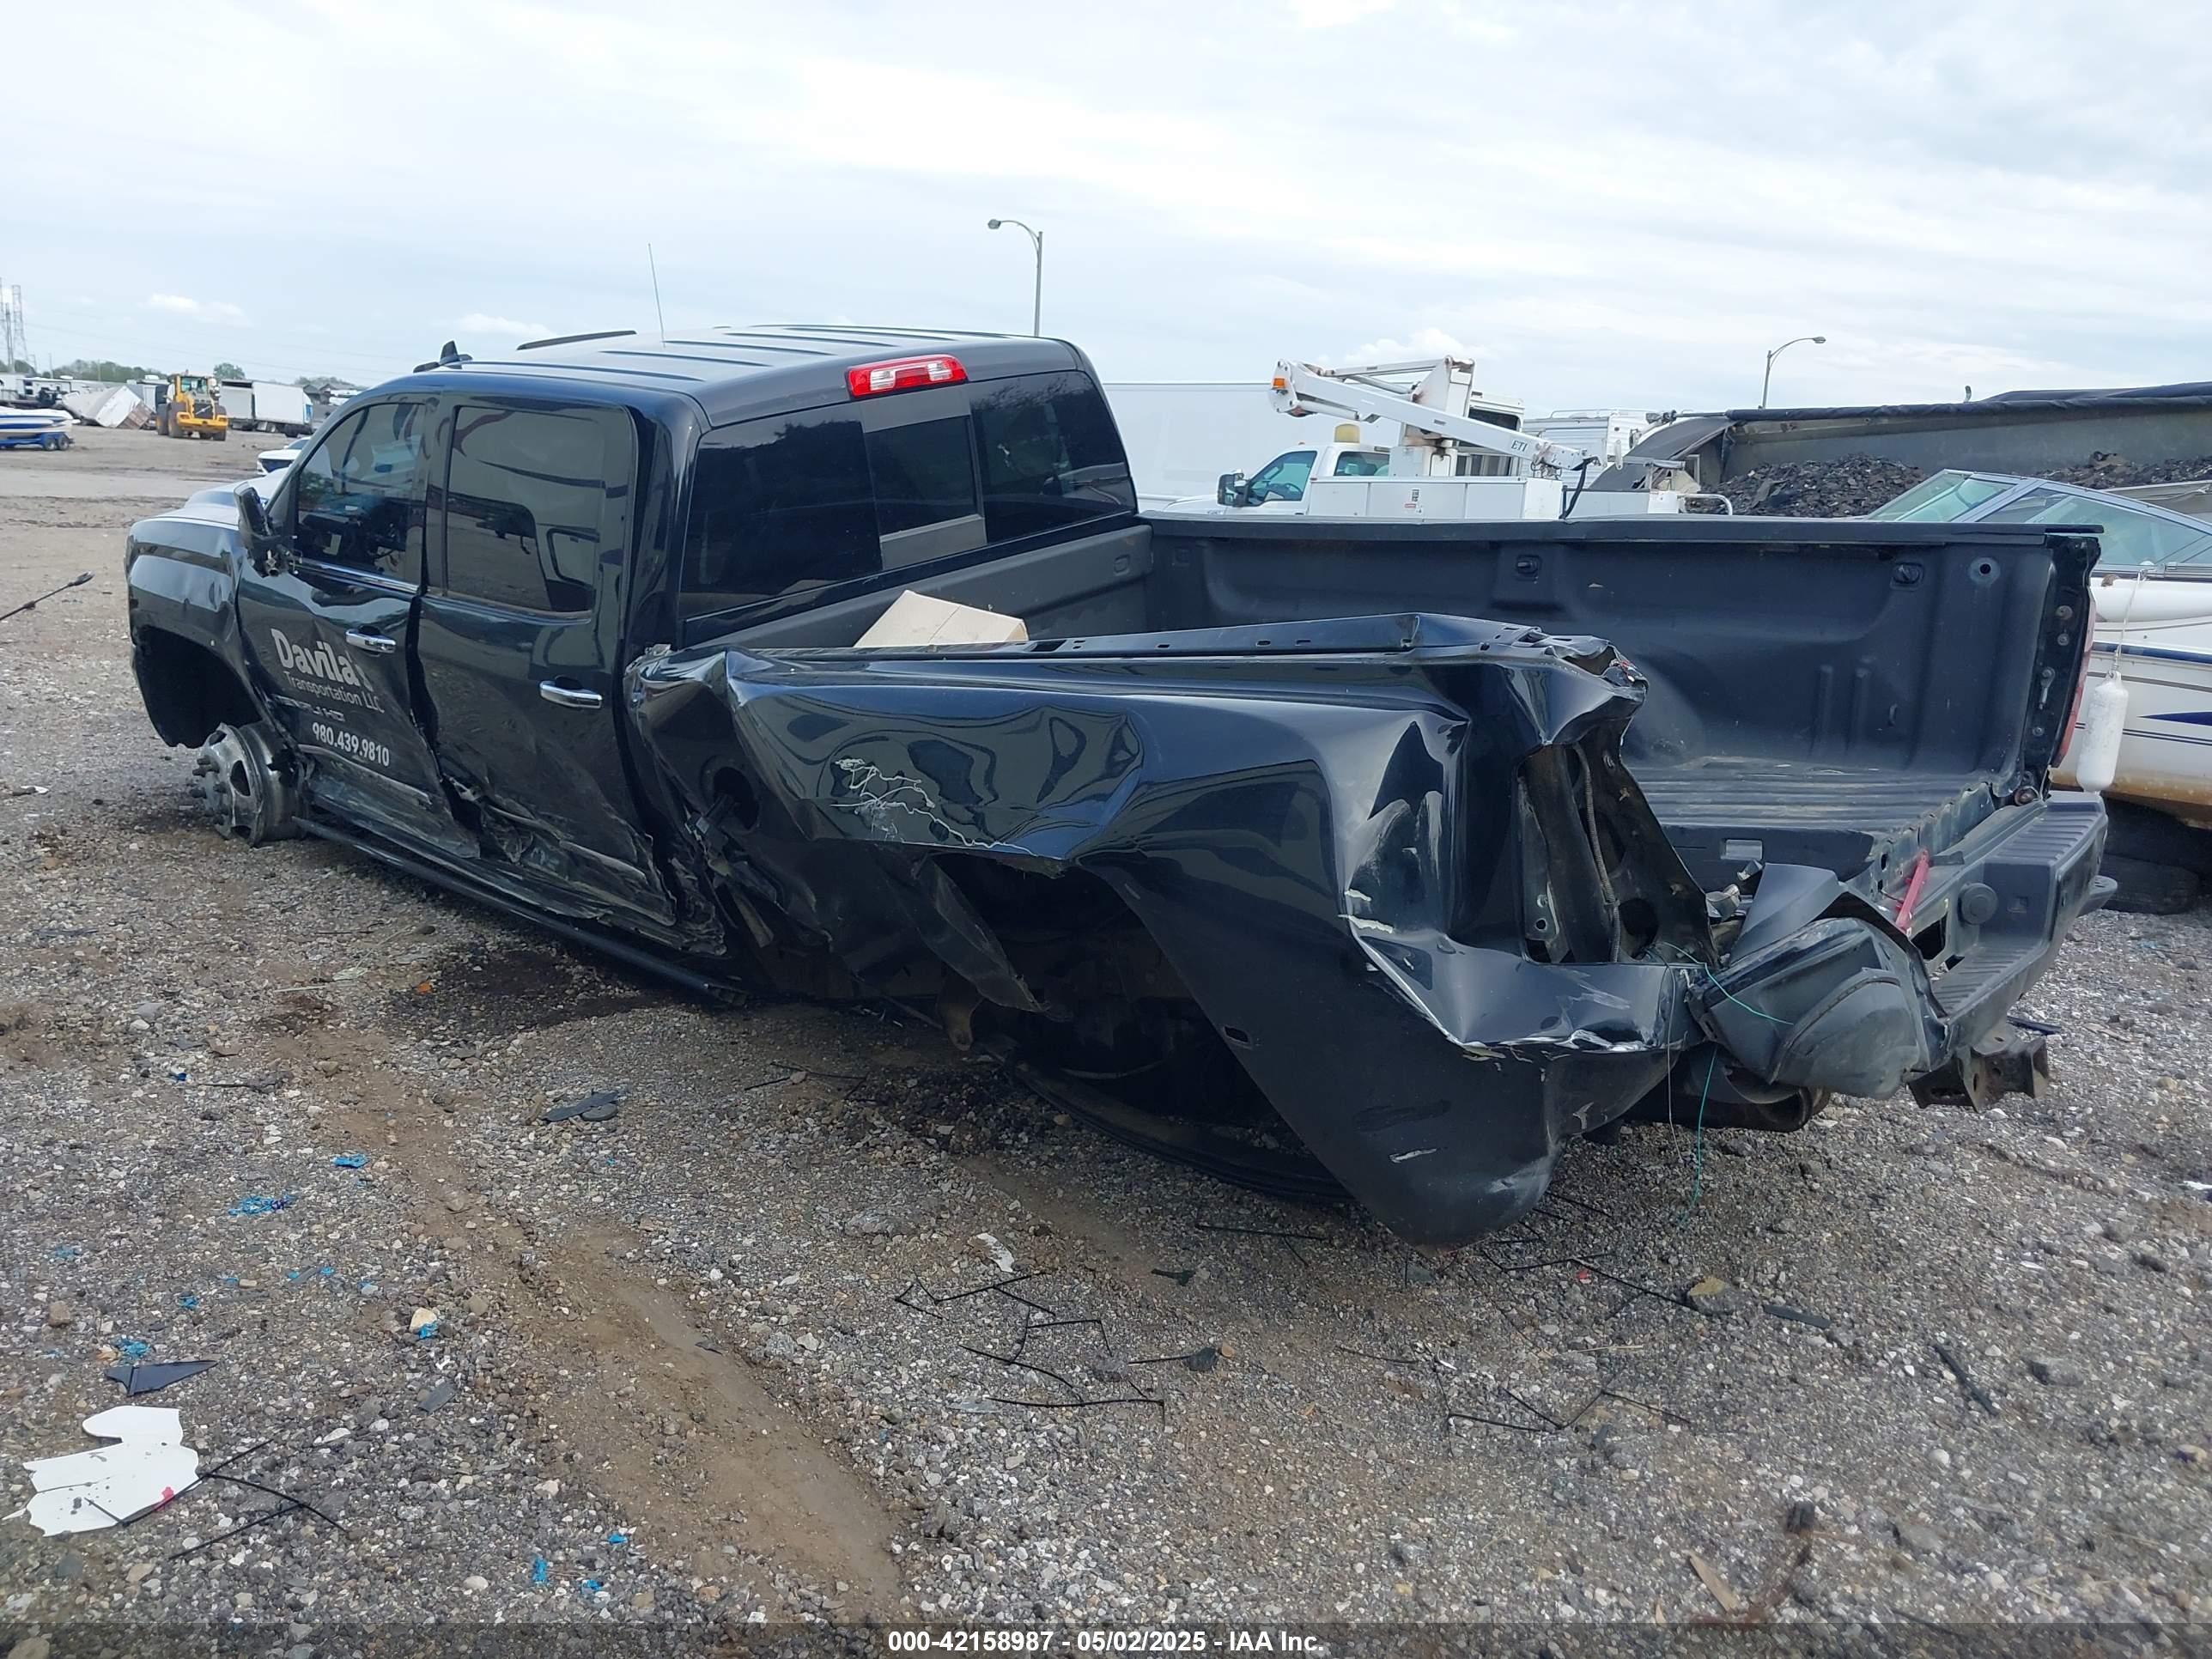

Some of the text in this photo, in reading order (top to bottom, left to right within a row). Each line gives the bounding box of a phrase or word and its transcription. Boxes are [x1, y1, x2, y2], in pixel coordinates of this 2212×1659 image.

[1511, 440, 1528, 453] ETI
[283, 671, 362, 706] Transportation
[313, 722, 389, 766] 980.439.9810
